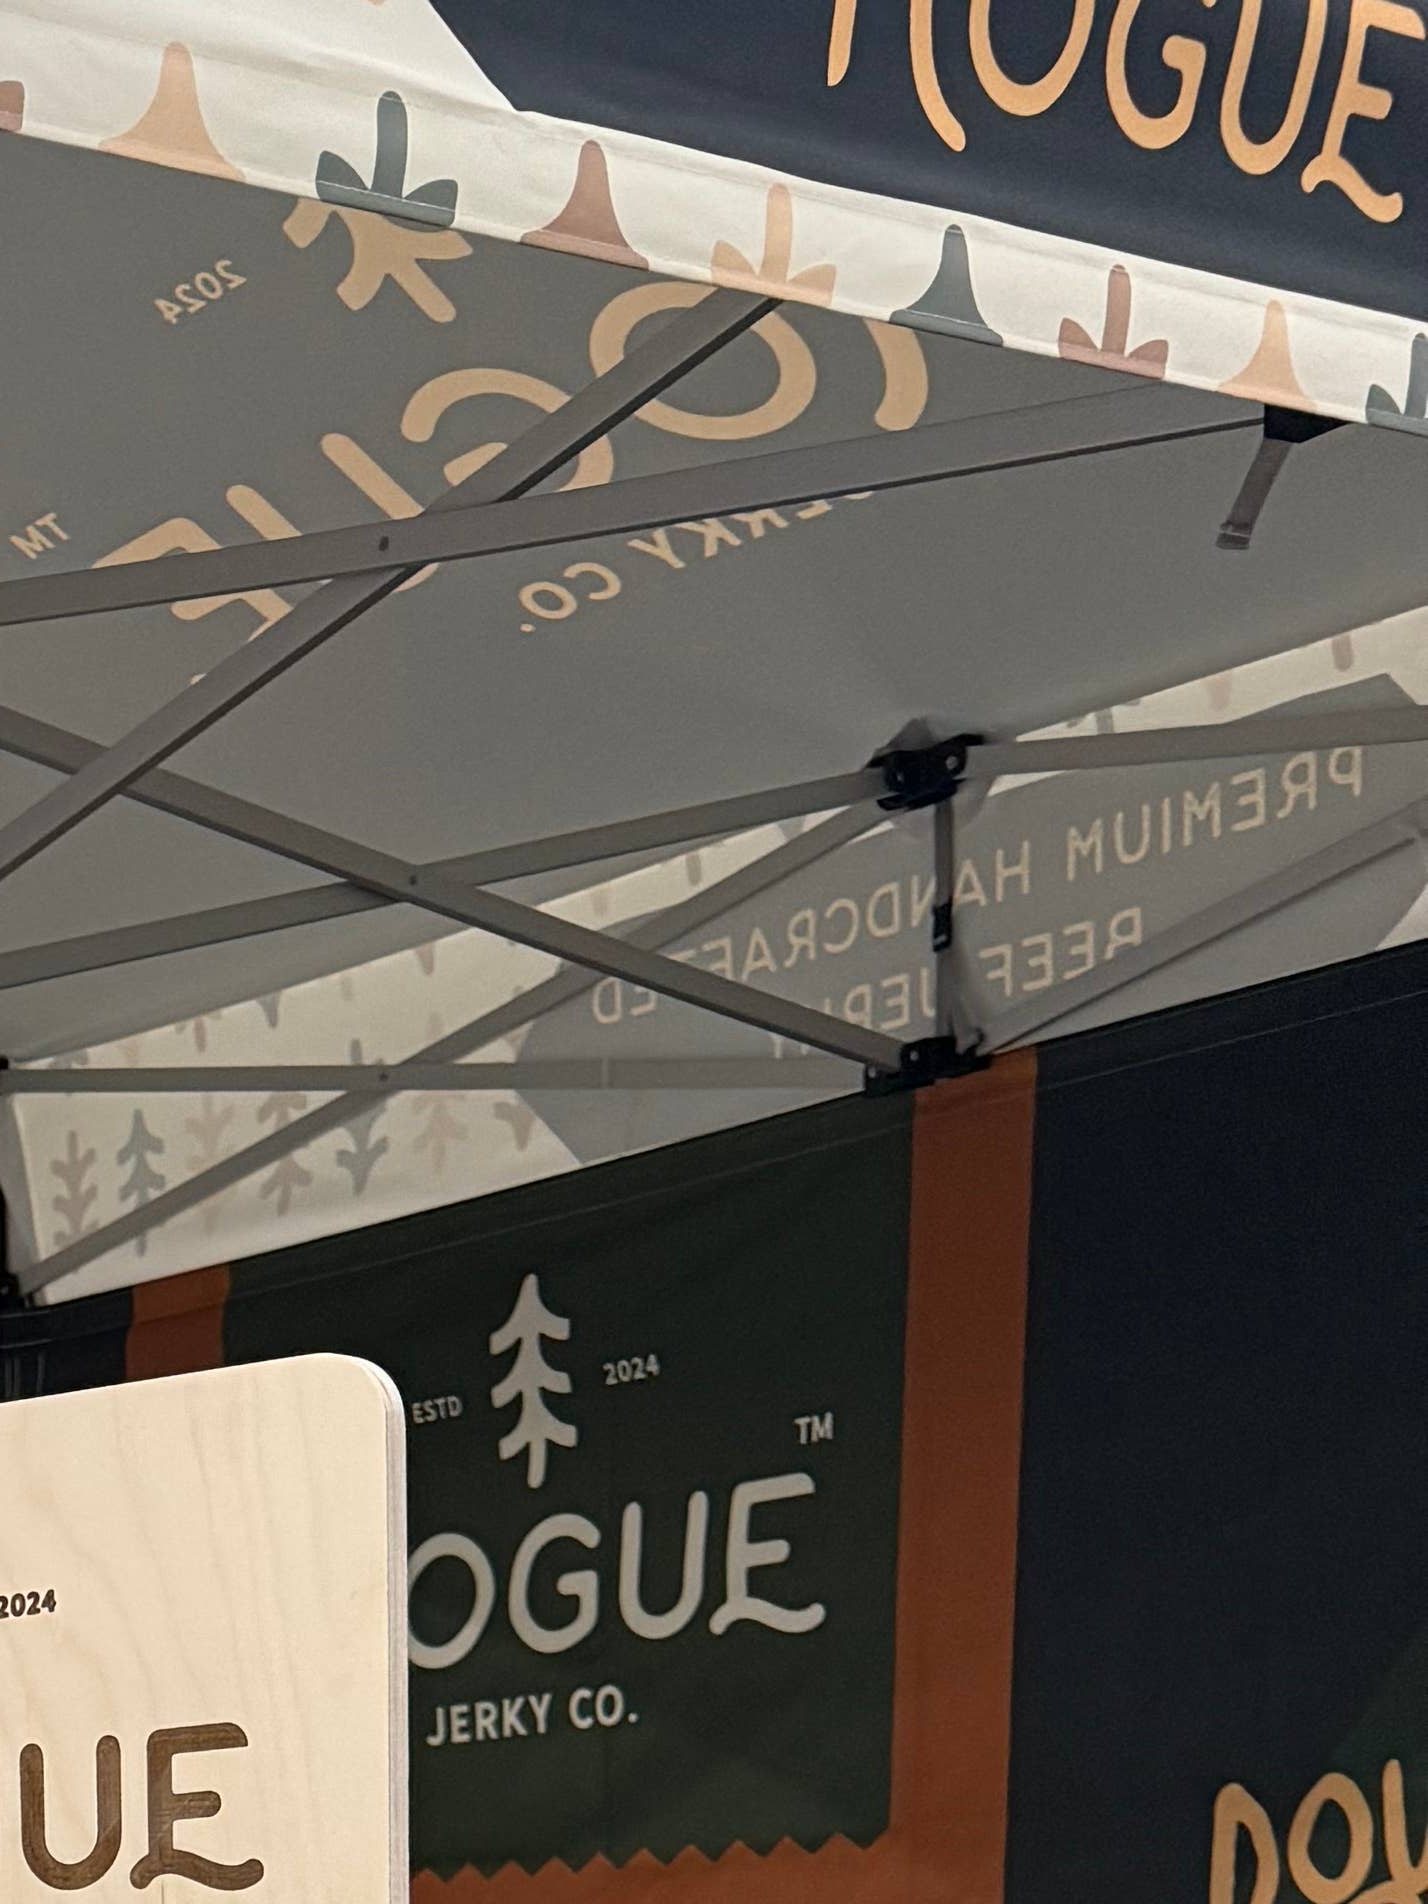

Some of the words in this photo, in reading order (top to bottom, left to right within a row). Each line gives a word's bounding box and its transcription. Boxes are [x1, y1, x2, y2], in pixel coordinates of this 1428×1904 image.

[603, 1353, 661, 1386] 2024
[412, 1395, 463, 1425] ESTD
[794, 1412, 834, 1445] TM
[407, 1472, 827, 1669] OGUE
[425, 1693, 553, 1747] JERKY
[568, 1684, 640, 1730] CO.
